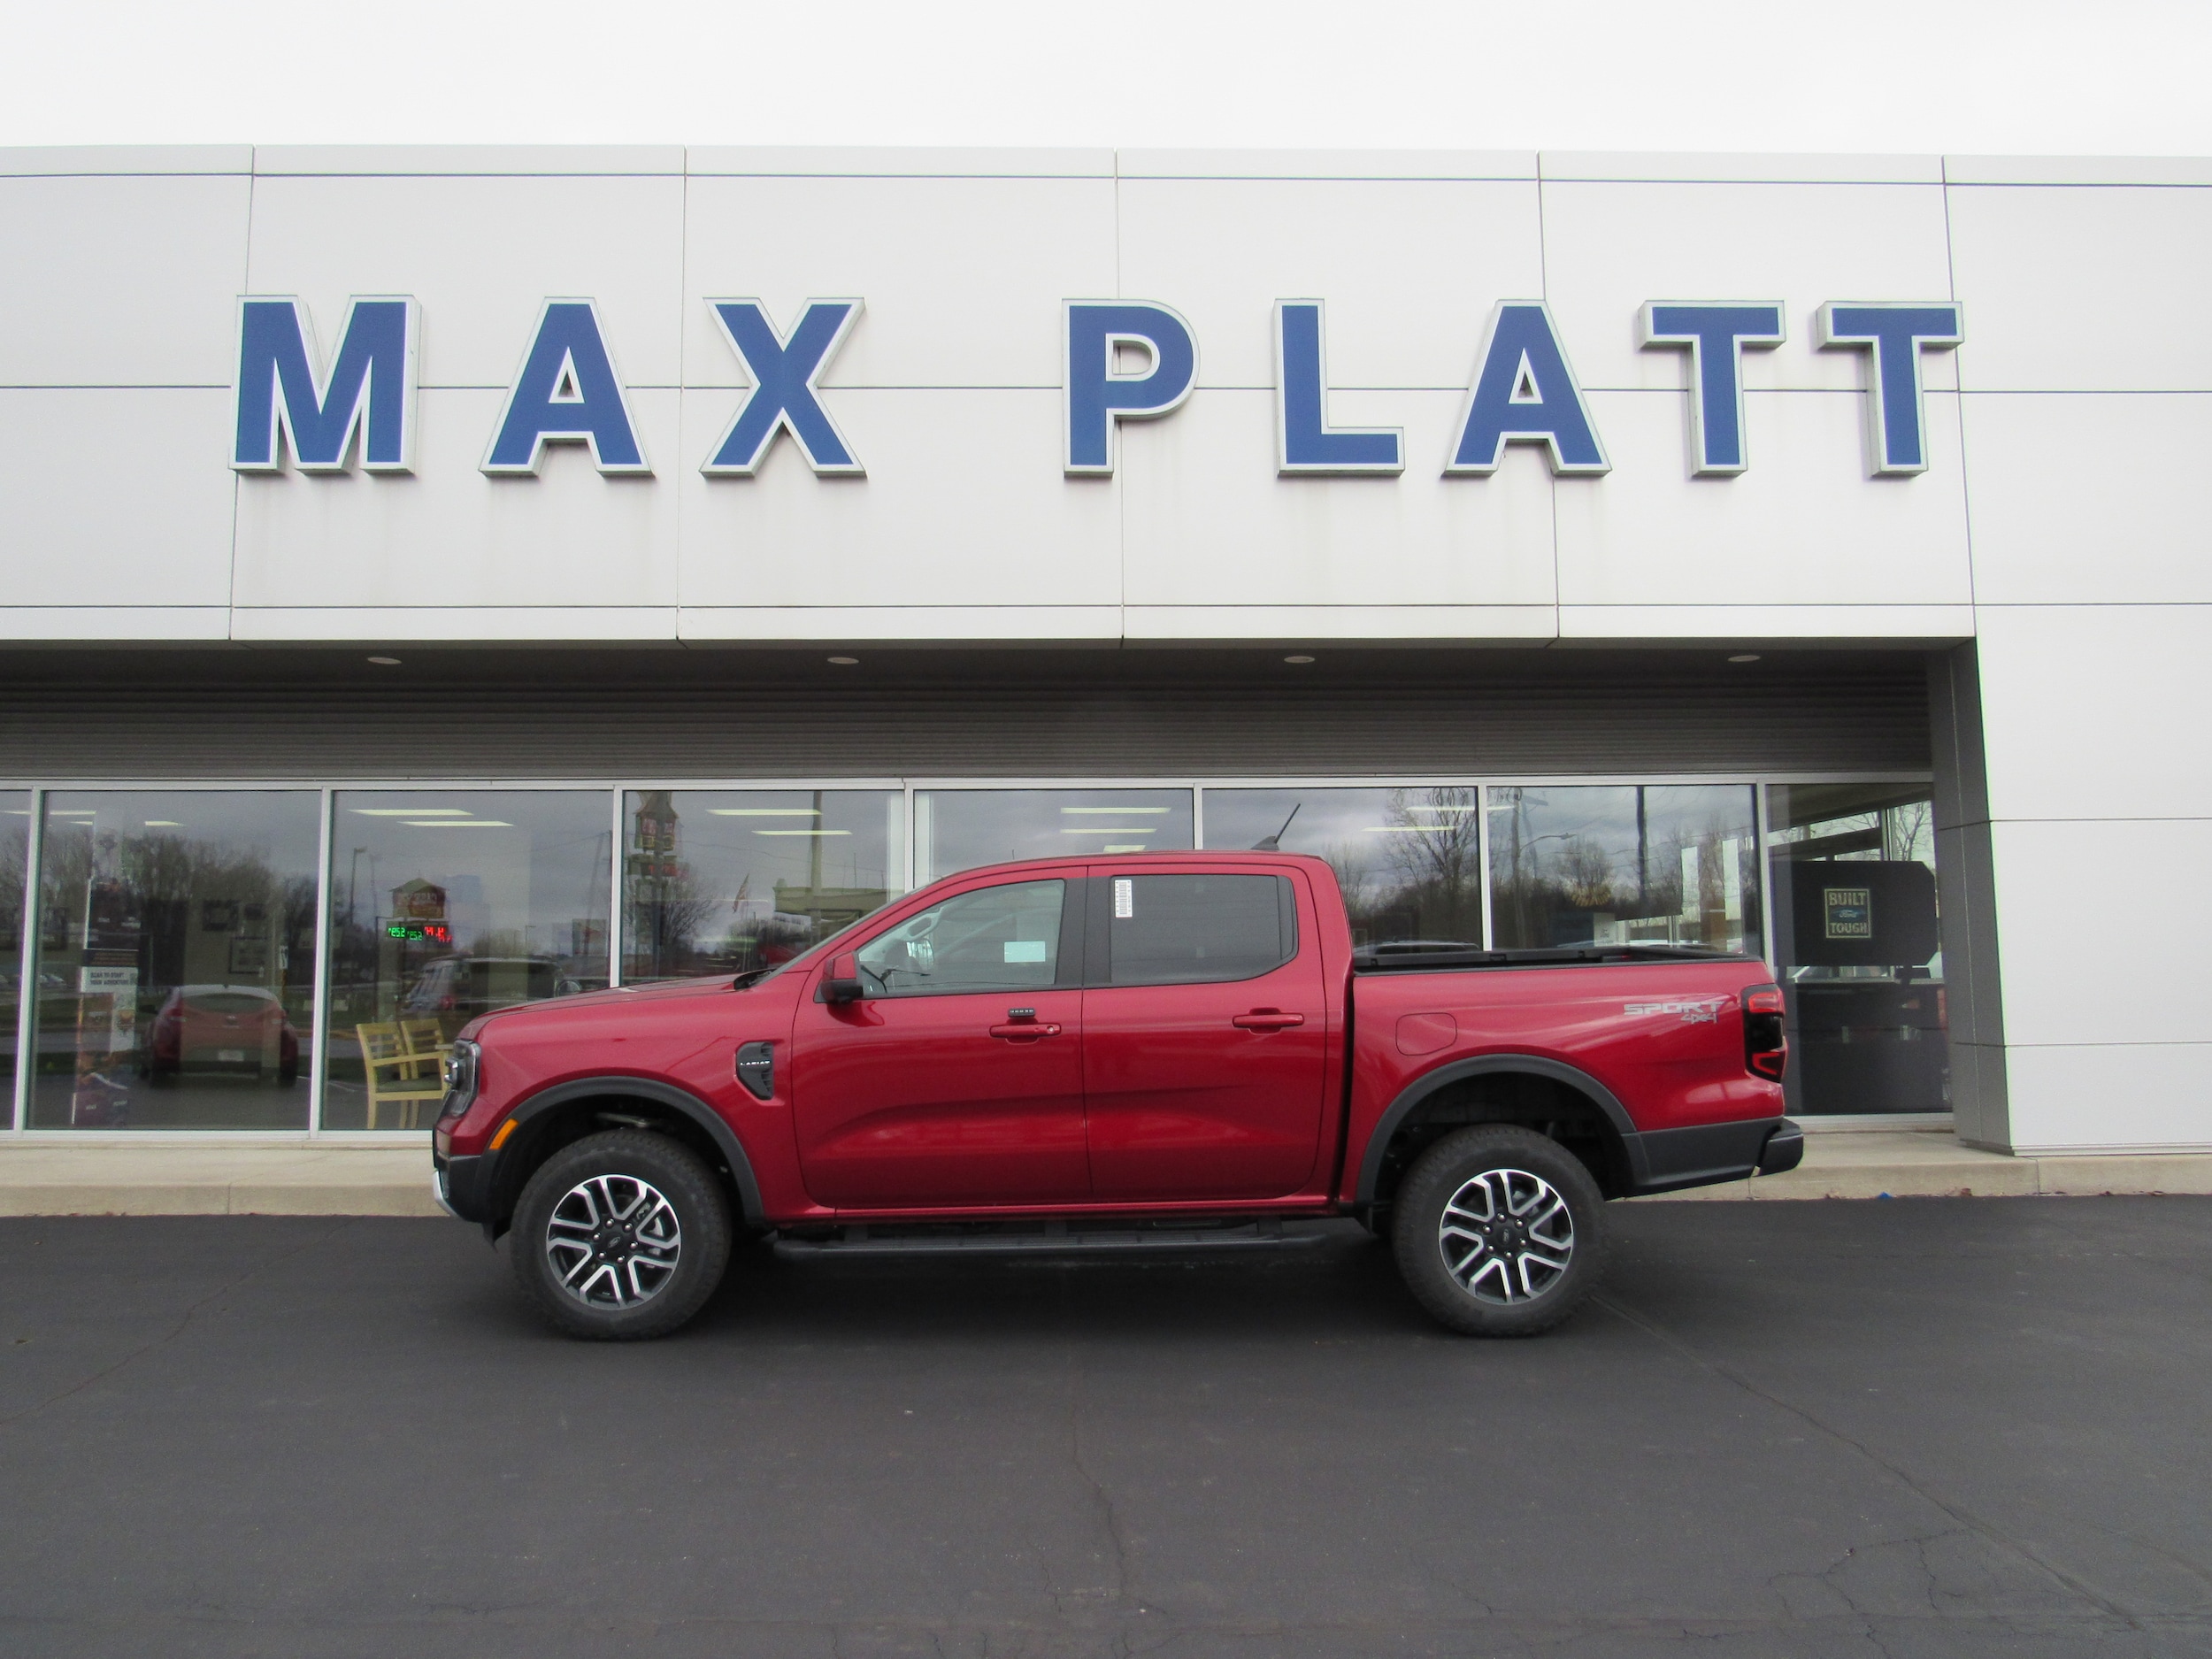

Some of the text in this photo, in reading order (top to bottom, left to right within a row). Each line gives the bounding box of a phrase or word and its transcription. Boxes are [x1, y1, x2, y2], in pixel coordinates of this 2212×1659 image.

[229, 295, 1964, 478] MAX PLATT
[1828, 892, 1866, 906] BUILT
[1830, 922, 1868, 933] TOUGH
[1624, 1001, 1725, 1016] SPORT
